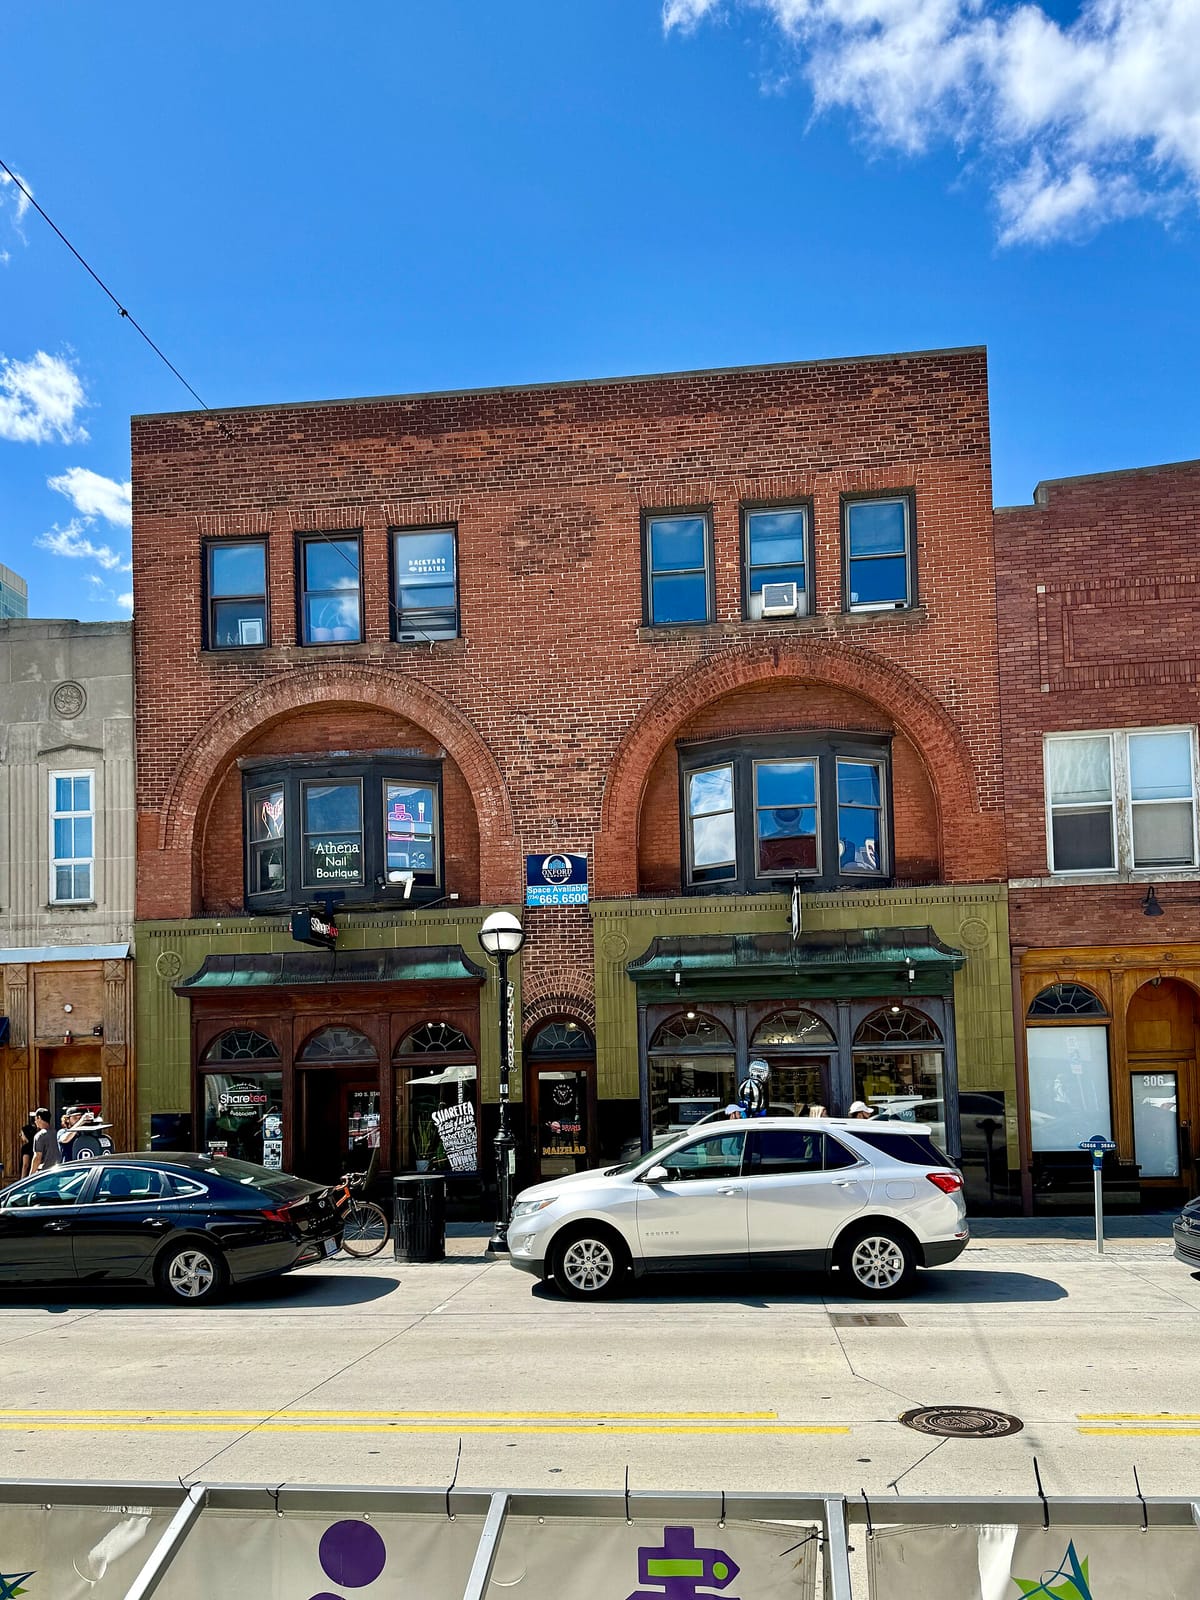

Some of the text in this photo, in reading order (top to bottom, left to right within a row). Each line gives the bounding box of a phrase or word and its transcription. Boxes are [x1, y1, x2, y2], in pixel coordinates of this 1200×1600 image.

[315, 841, 360, 855] Athena
[325, 856, 347, 867] Nail
[316, 867, 359, 879] Boutique
[541, 868, 573, 876] OXFORD
[527, 885, 588, 894] Space Available
[540, 893, 588, 904] 665.6500
[1143, 1075, 1164, 1087] 306
[219, 1092, 268, 1104] Sharetea
[432, 1101, 475, 1126] SHARETEA
